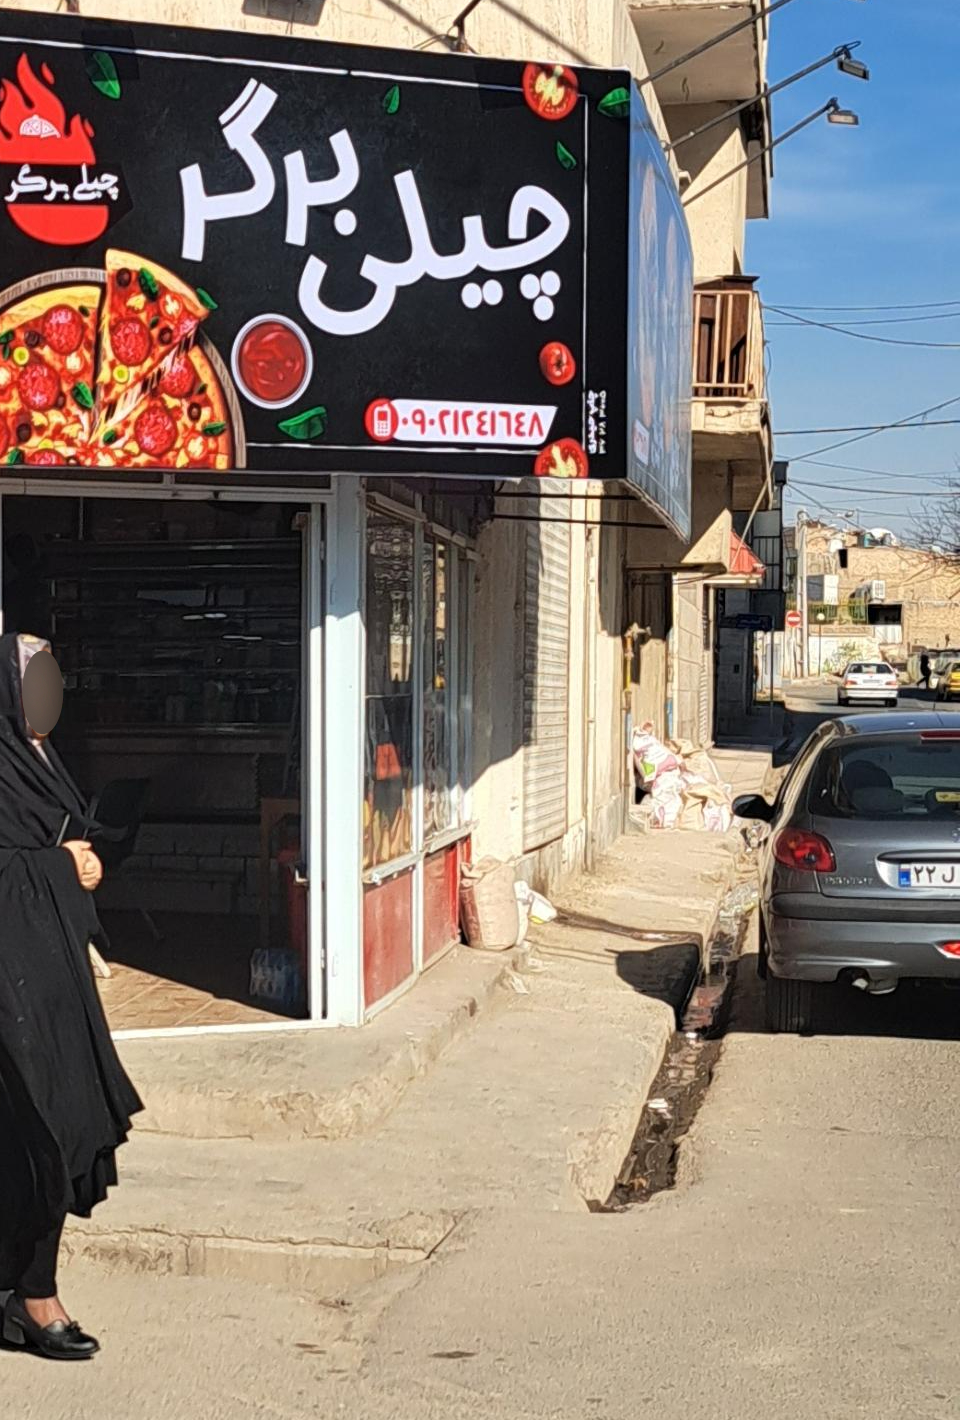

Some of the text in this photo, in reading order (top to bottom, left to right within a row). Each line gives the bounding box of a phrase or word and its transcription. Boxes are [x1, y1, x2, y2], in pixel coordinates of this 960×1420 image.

[3, 162, 119, 202] چیلی برگر
[179, 78, 571, 336] چیلی برگر
[914, 866, 936, 883] ۲۲
